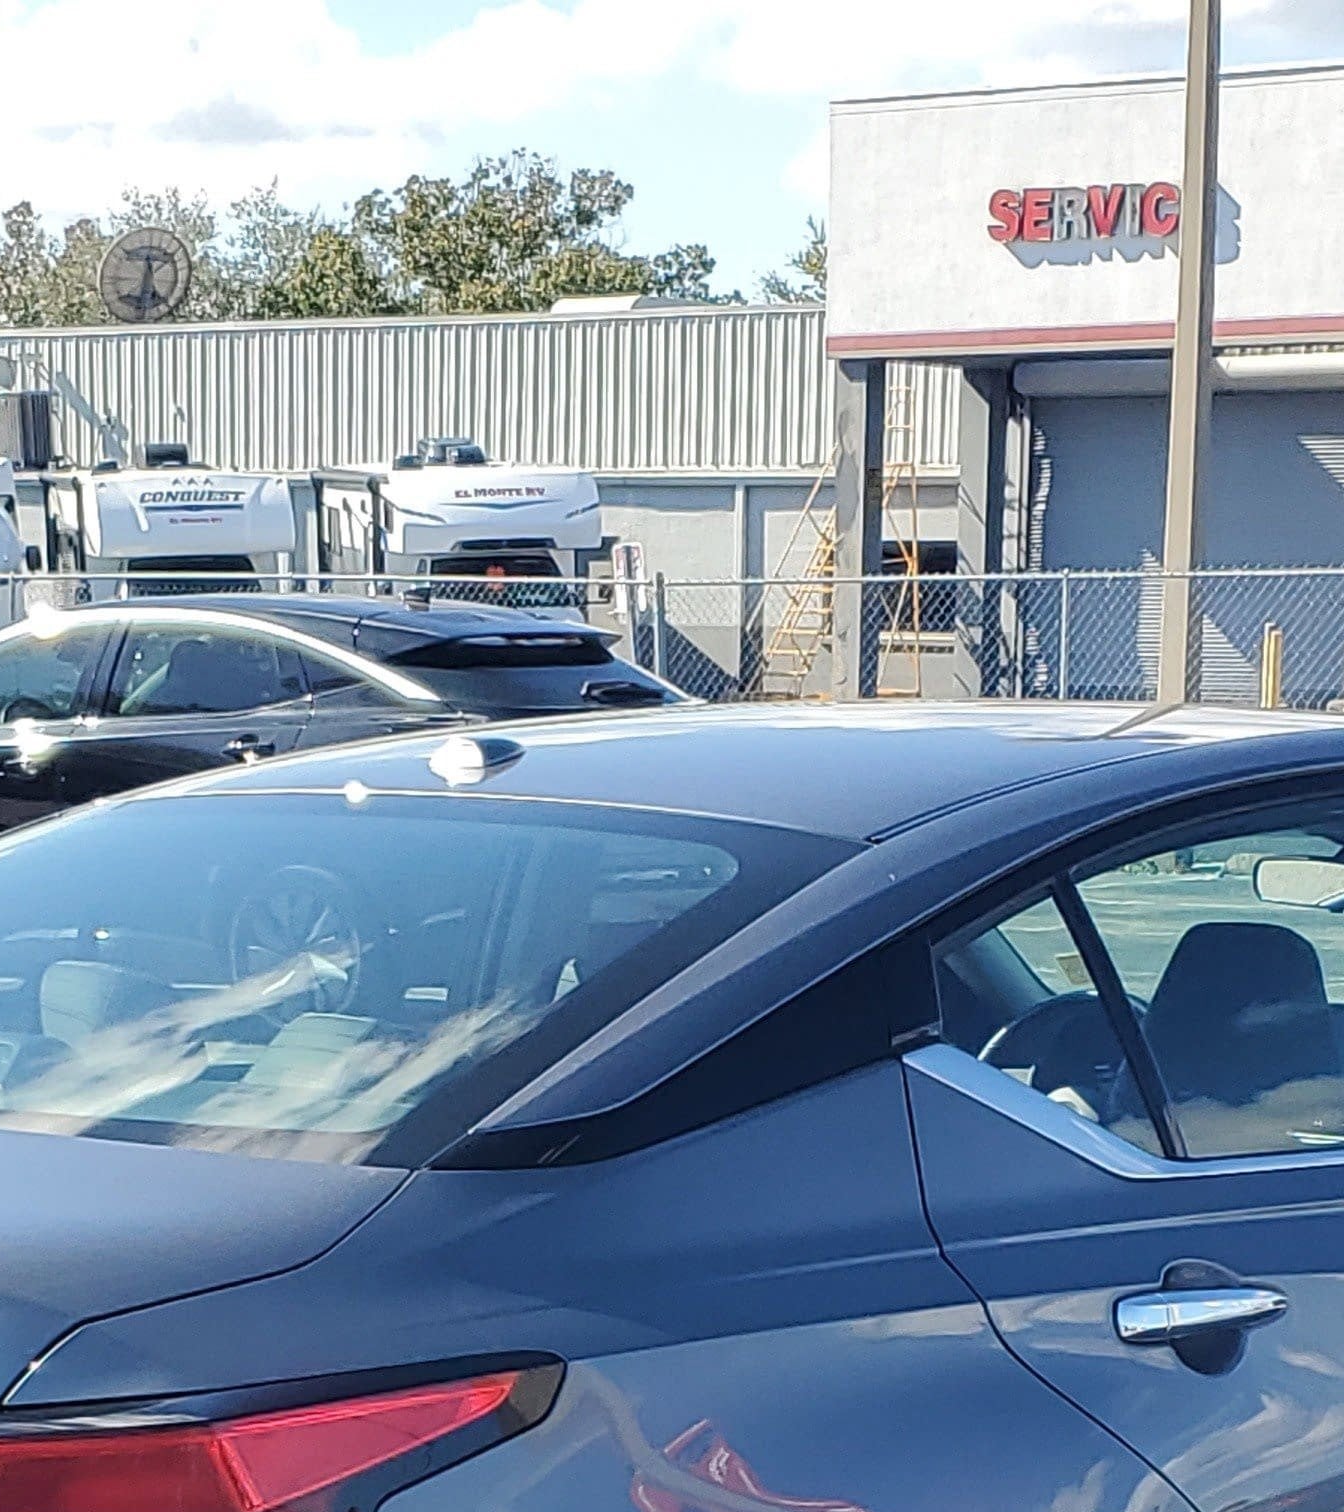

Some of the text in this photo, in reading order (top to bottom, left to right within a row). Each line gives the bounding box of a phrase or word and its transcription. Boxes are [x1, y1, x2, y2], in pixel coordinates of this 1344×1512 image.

[987, 182, 1181, 243] SERVIC
[139, 490, 246, 504] CONQUEST
[455, 490, 472, 498] EL
[474, 488, 523, 498] MONTE
